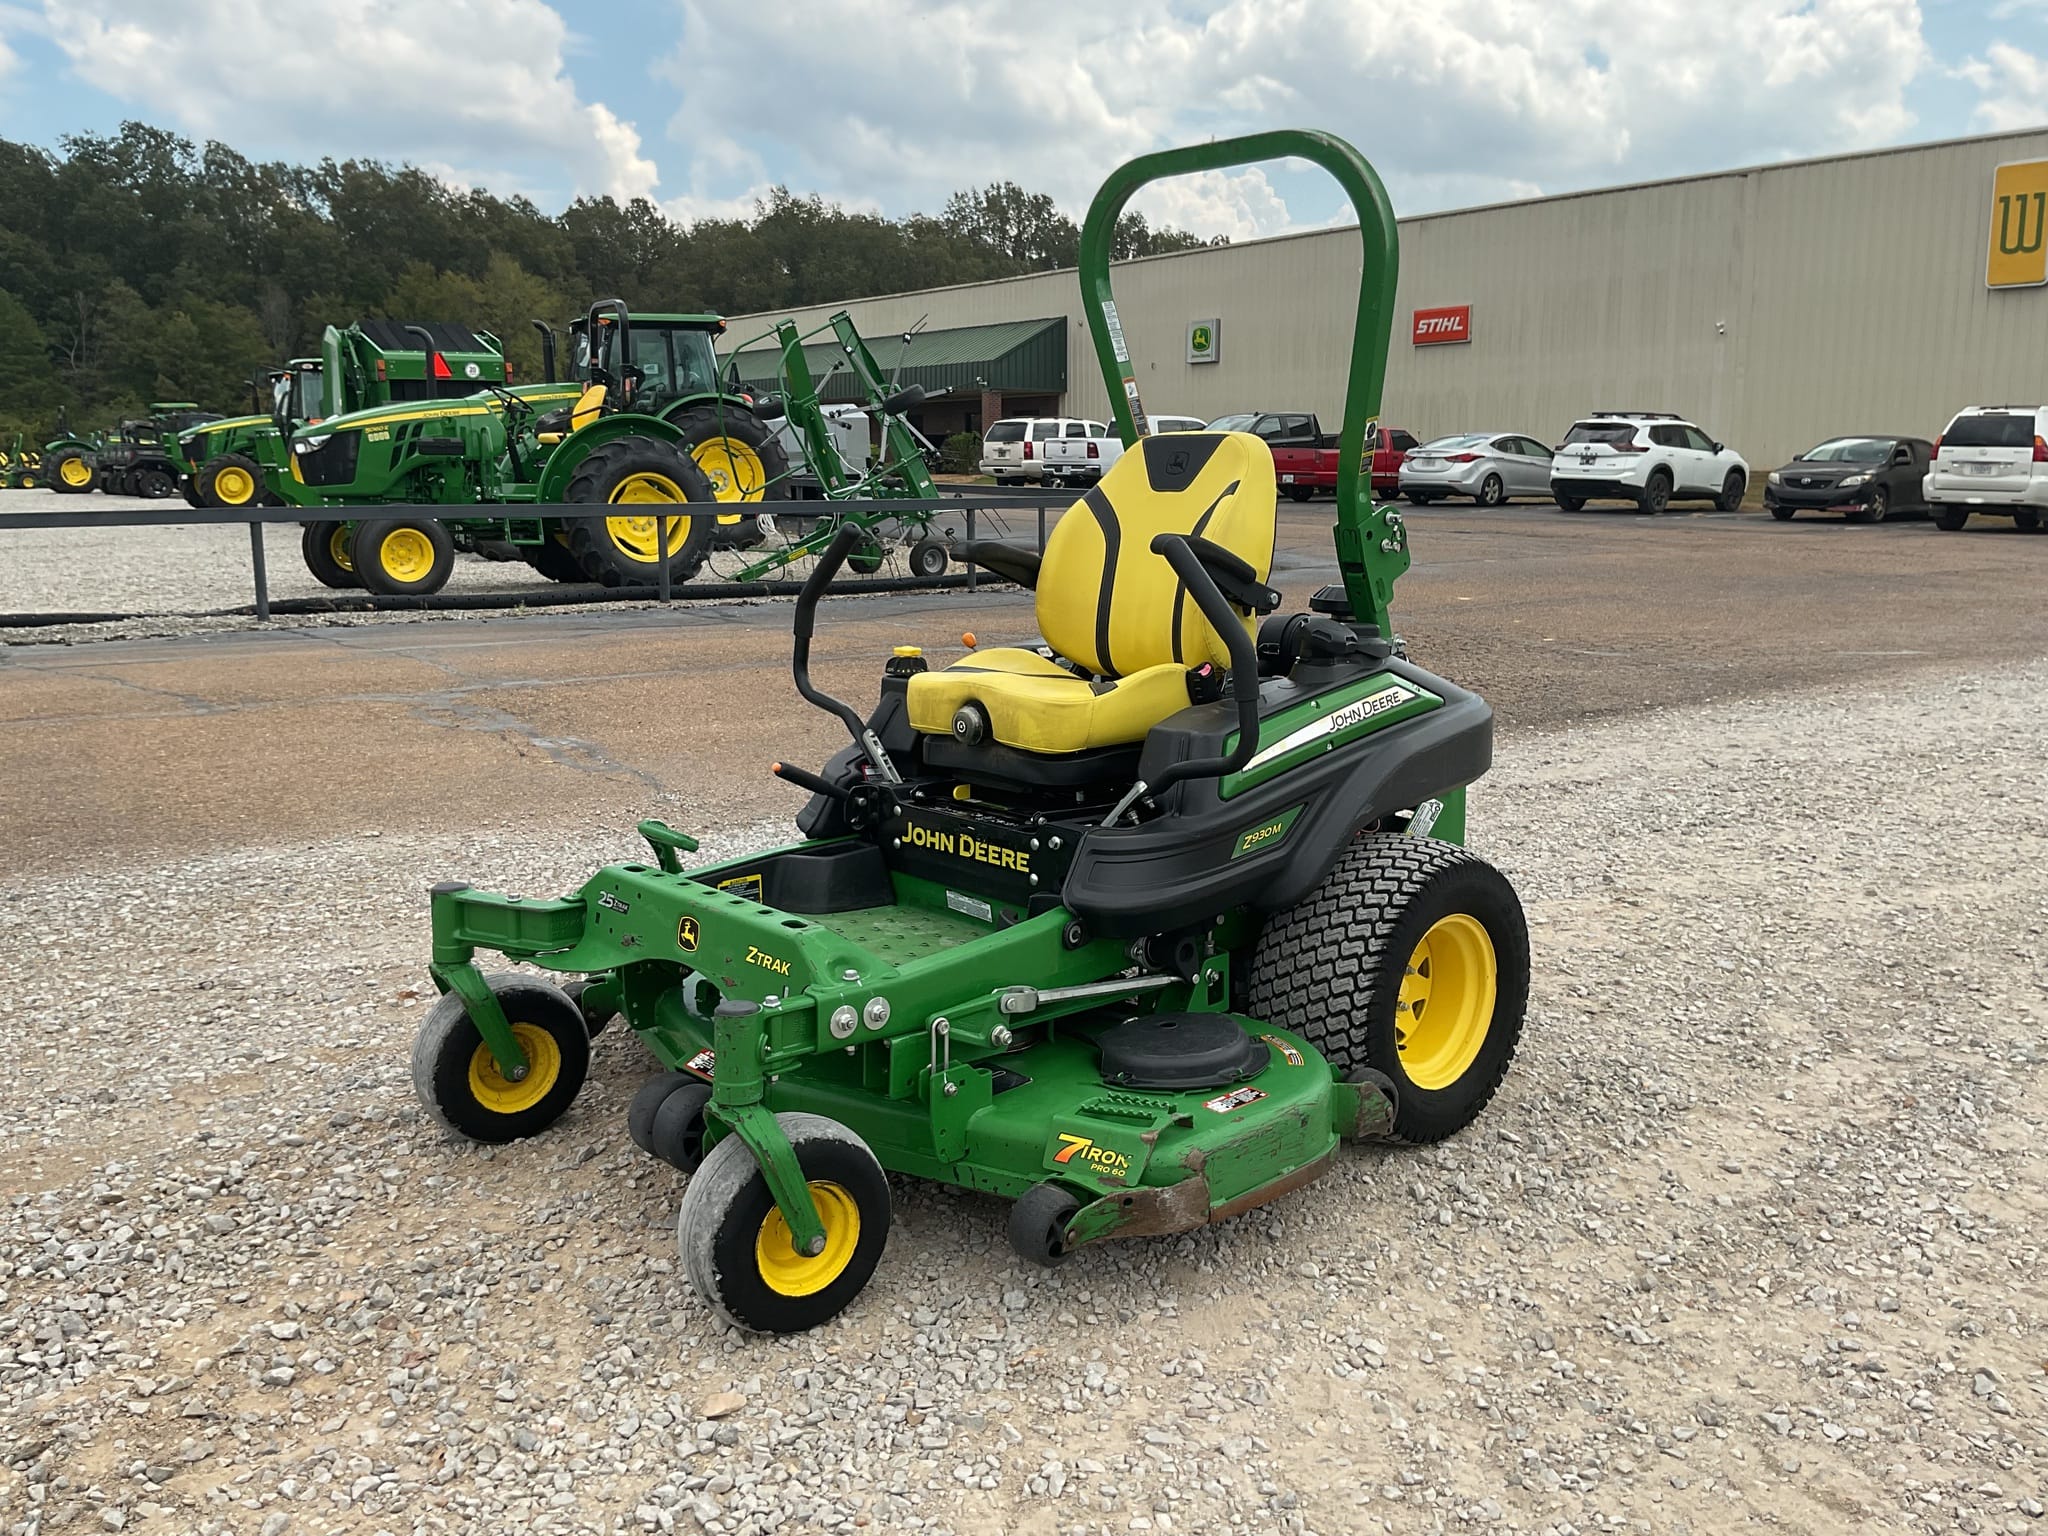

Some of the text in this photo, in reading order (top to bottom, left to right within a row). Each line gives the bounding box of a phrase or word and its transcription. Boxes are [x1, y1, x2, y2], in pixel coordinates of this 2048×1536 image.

[1998, 191, 2046, 254] W
[1416, 316, 1463, 335] STIHL
[1329, 691, 1401, 731] JOHN DEERE
[902, 821, 1030, 873] JOHN DEERE
[1242, 822, 1283, 850] Z930M
[598, 890, 614, 908] 25
[745, 945, 791, 976] ZTRAK
[1090, 1163, 1126, 1177] PRO 60
